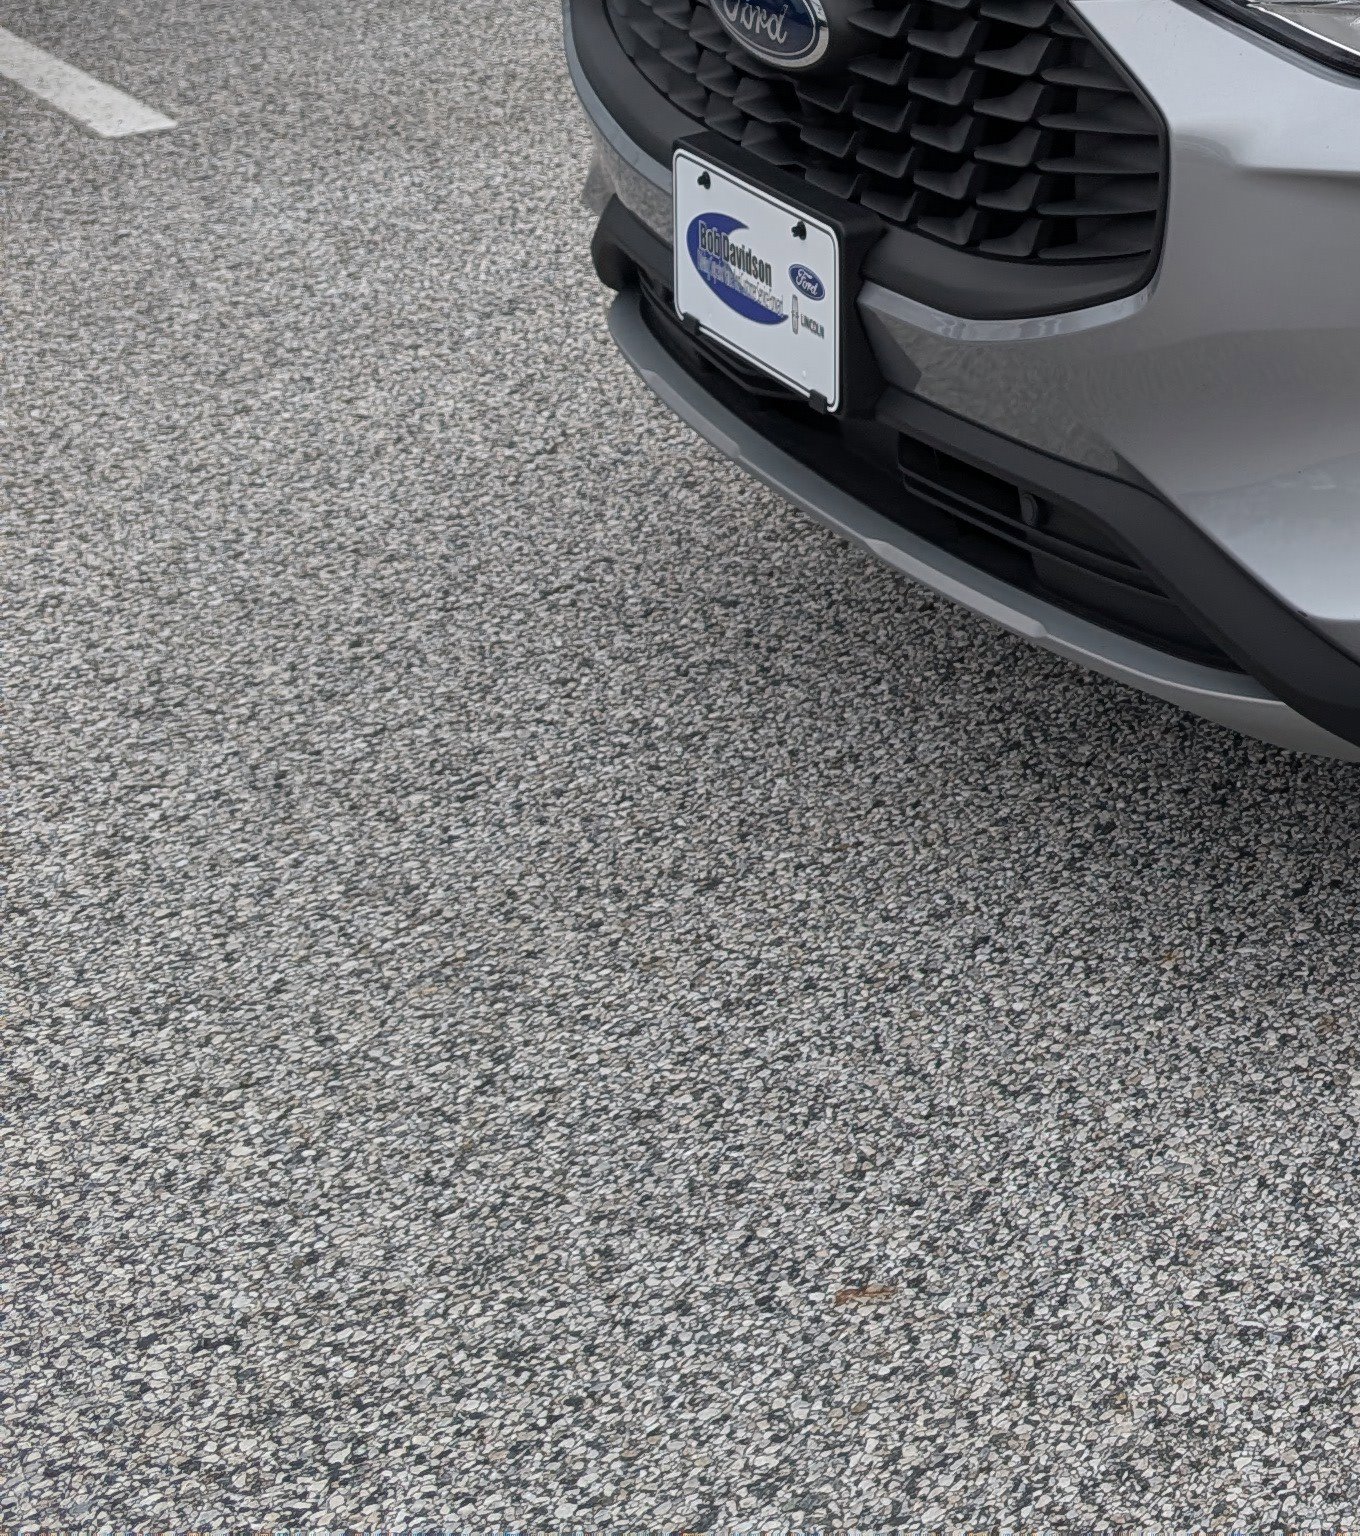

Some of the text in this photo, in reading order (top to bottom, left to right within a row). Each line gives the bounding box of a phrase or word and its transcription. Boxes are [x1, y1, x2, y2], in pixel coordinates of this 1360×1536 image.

[698, 220, 721, 261] Bob
[721, 232, 773, 287] Davidson
[795, 268, 819, 296] Ford
[800, 313, 825, 339] LINCOLN
